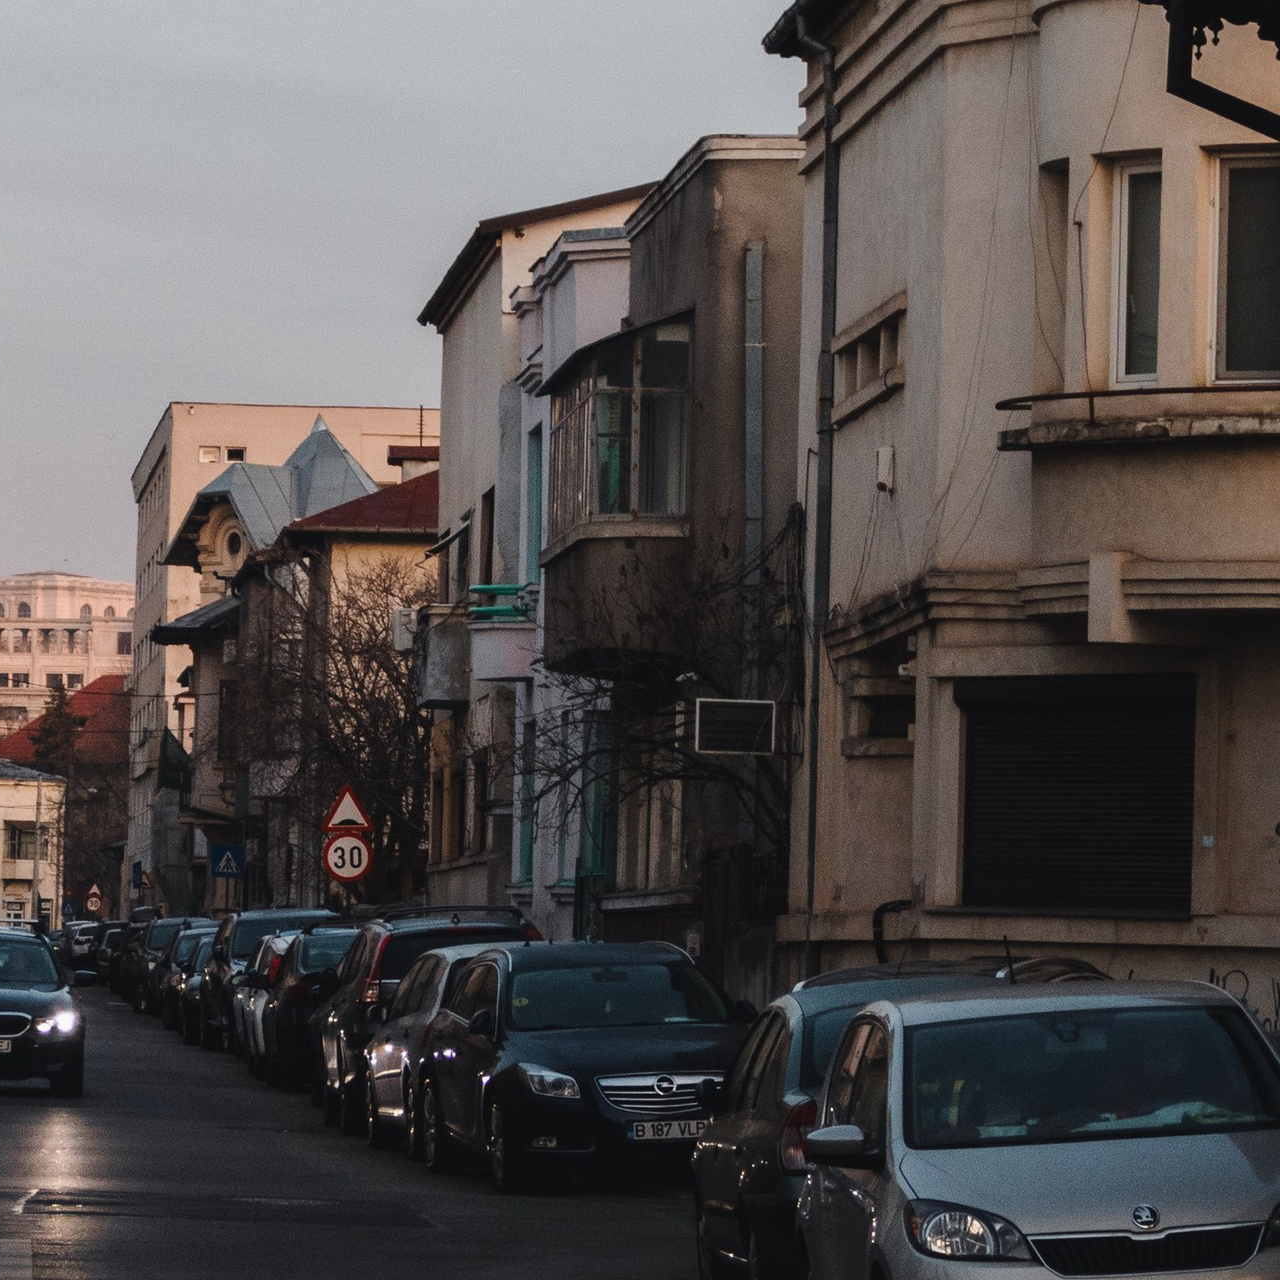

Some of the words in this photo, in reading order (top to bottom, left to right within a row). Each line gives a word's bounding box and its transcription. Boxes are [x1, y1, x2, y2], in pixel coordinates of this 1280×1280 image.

[334, 846, 362, 869] 30
[635, 1124, 646, 1138] B
[651, 1122, 672, 1137] 187
[678, 1121, 706, 1136] VLP
